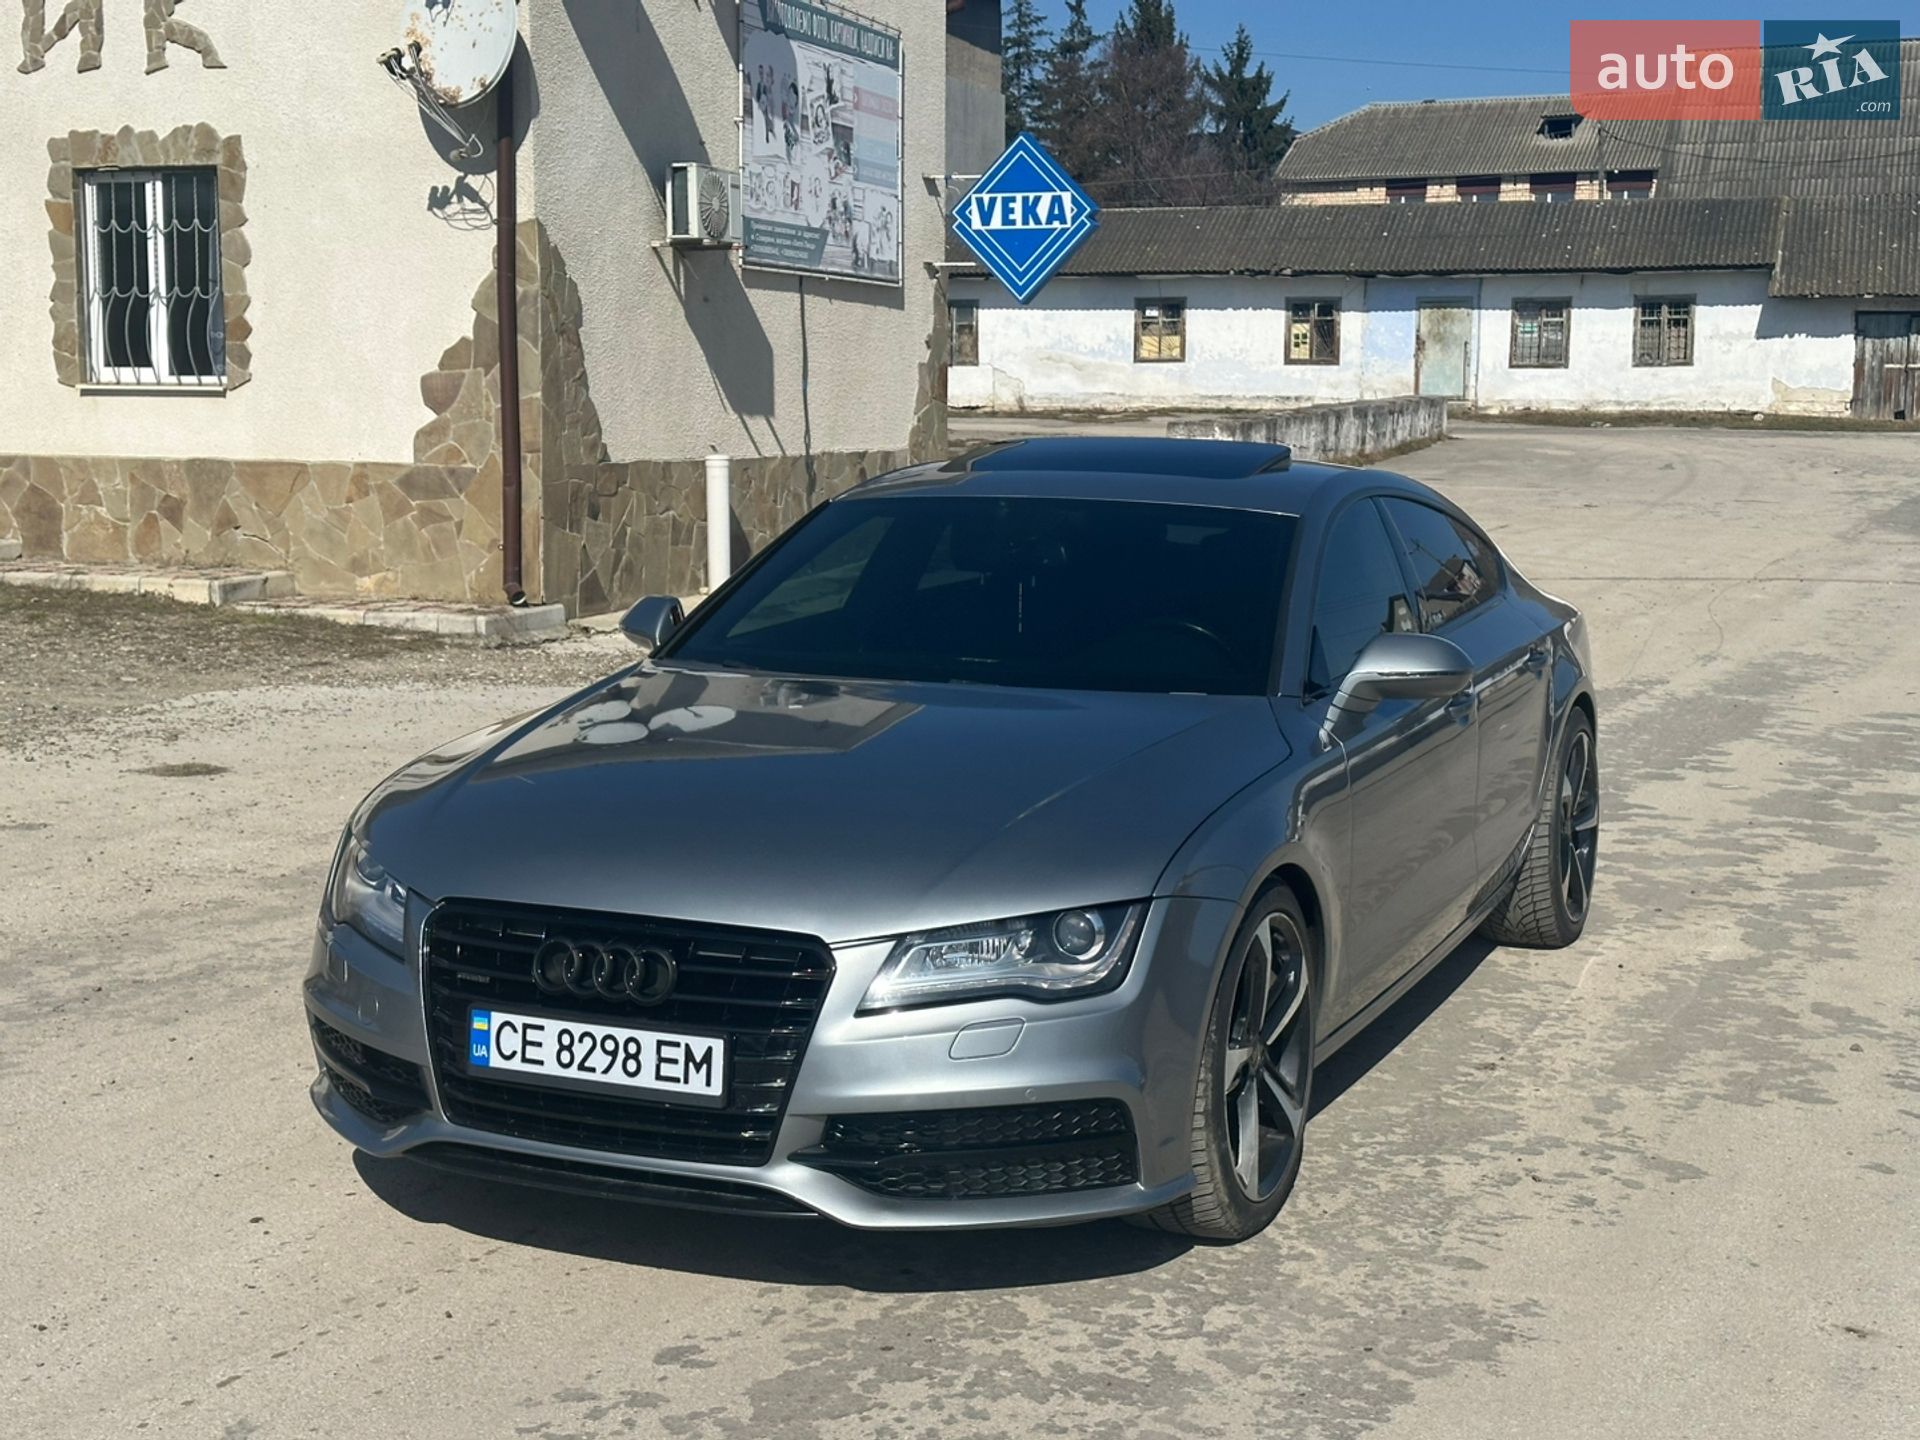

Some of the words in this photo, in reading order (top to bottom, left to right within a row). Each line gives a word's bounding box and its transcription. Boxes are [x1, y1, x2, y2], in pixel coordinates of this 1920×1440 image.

[975, 194, 1068, 227] VEKA
[472, 1043, 488, 1058] UA
[495, 1020, 545, 1066] CE
[556, 1028, 642, 1078] 8298
[655, 1039, 713, 1088] EM
